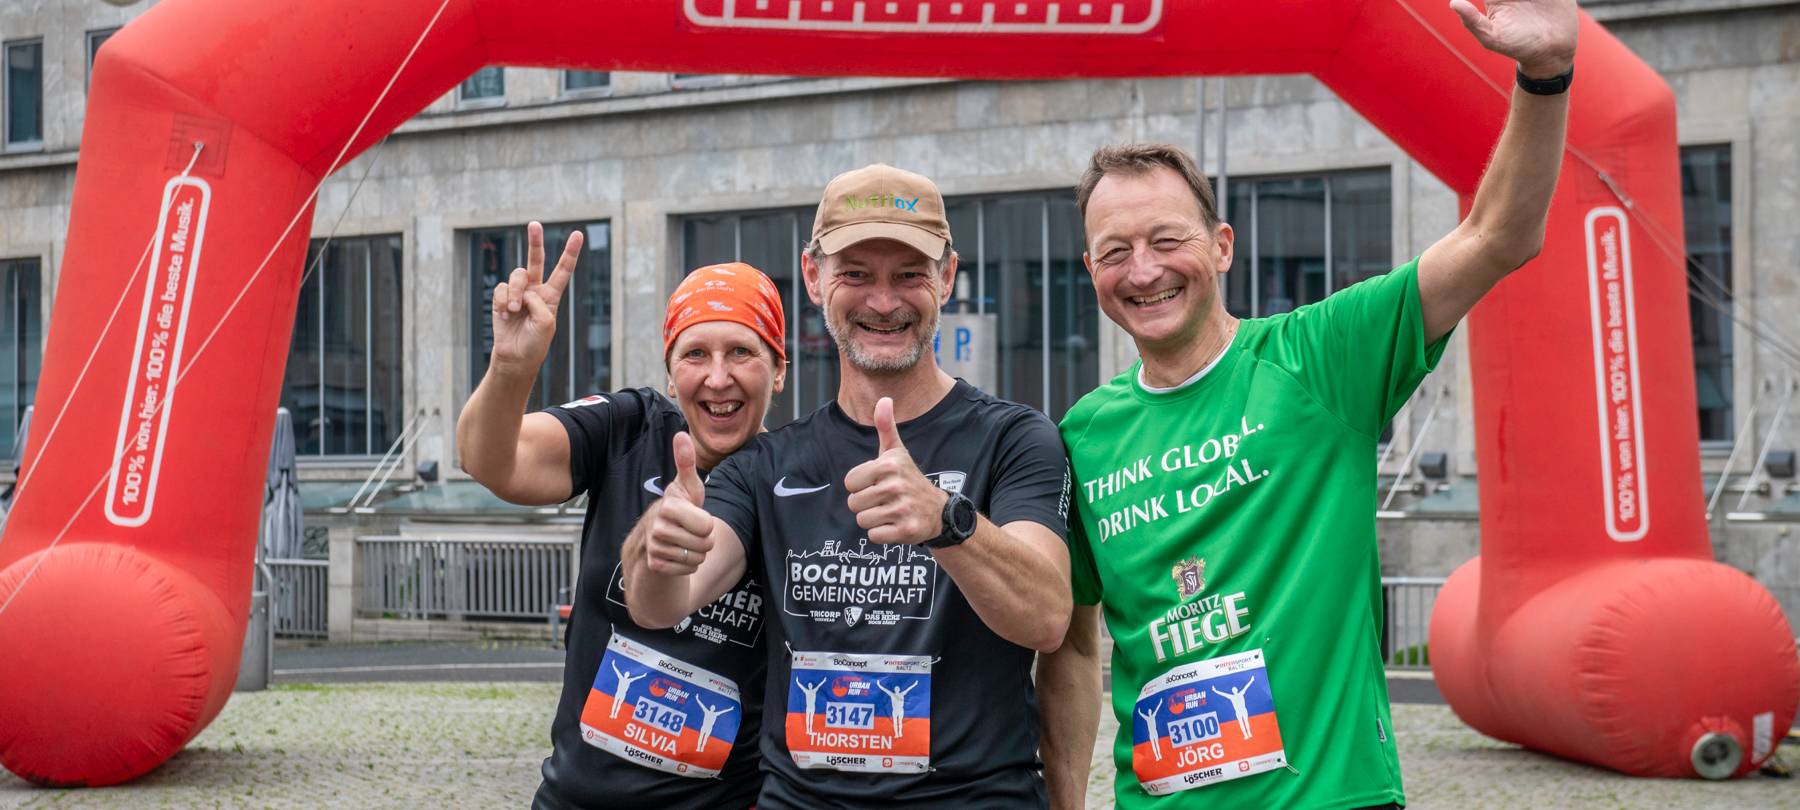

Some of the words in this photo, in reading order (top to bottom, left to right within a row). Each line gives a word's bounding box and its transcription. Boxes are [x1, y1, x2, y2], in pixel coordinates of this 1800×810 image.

[170, 198, 194, 252] Musik.
[1601, 225, 1619, 280] Musik.
[161, 254, 184, 302] beste
[157, 304, 175, 330] die
[1607, 281, 1622, 328] beste
[1608, 328, 1625, 354] die
[146, 331, 169, 381] 100%
[1610, 354, 1627, 404] 100%
[139, 384, 159, 419] hier.
[1614, 404, 1630, 440] hier.
[136, 421, 152, 452] von
[1083, 455, 1153, 505] THINK
[1161, 415, 1265, 472] GLOBL.
[1618, 441, 1632, 471] von
[122, 455, 146, 506] 100%
[1618, 472, 1636, 522] 100%
[1097, 494, 1169, 544] DRINK
[791, 562, 927, 586] BOCHUMER
[792, 586, 926, 604] GEMEINSCHAFT
[1167, 593, 1221, 623] MORITZ
[809, 610, 841, 618] TRICORP
[1149, 591, 1251, 663] FIEGE
[658, 660, 693, 678] BoConcept
[833, 658, 867, 668] BoConcept
[664, 692, 678, 702] RUN
[668, 686, 690, 699] URBAN
[848, 688, 861, 696] RUN
[850, 681, 871, 689] URBAN
[1185, 690, 1206, 702] URBAN
[635, 700, 684, 732] 3148
[827, 706, 873, 726] 3147
[1185, 700, 1198, 710] RUN
[624, 722, 678, 756] SILVIA
[809, 732, 892, 750] THORSTEN
[1170, 716, 1218, 744] 3100
[624, 745, 663, 765] LÖSCHER
[826, 756, 866, 766] LÖSCHER
[1176, 742, 1225, 768] JÖRG
[1184, 767, 1223, 784] LÖSCHER
